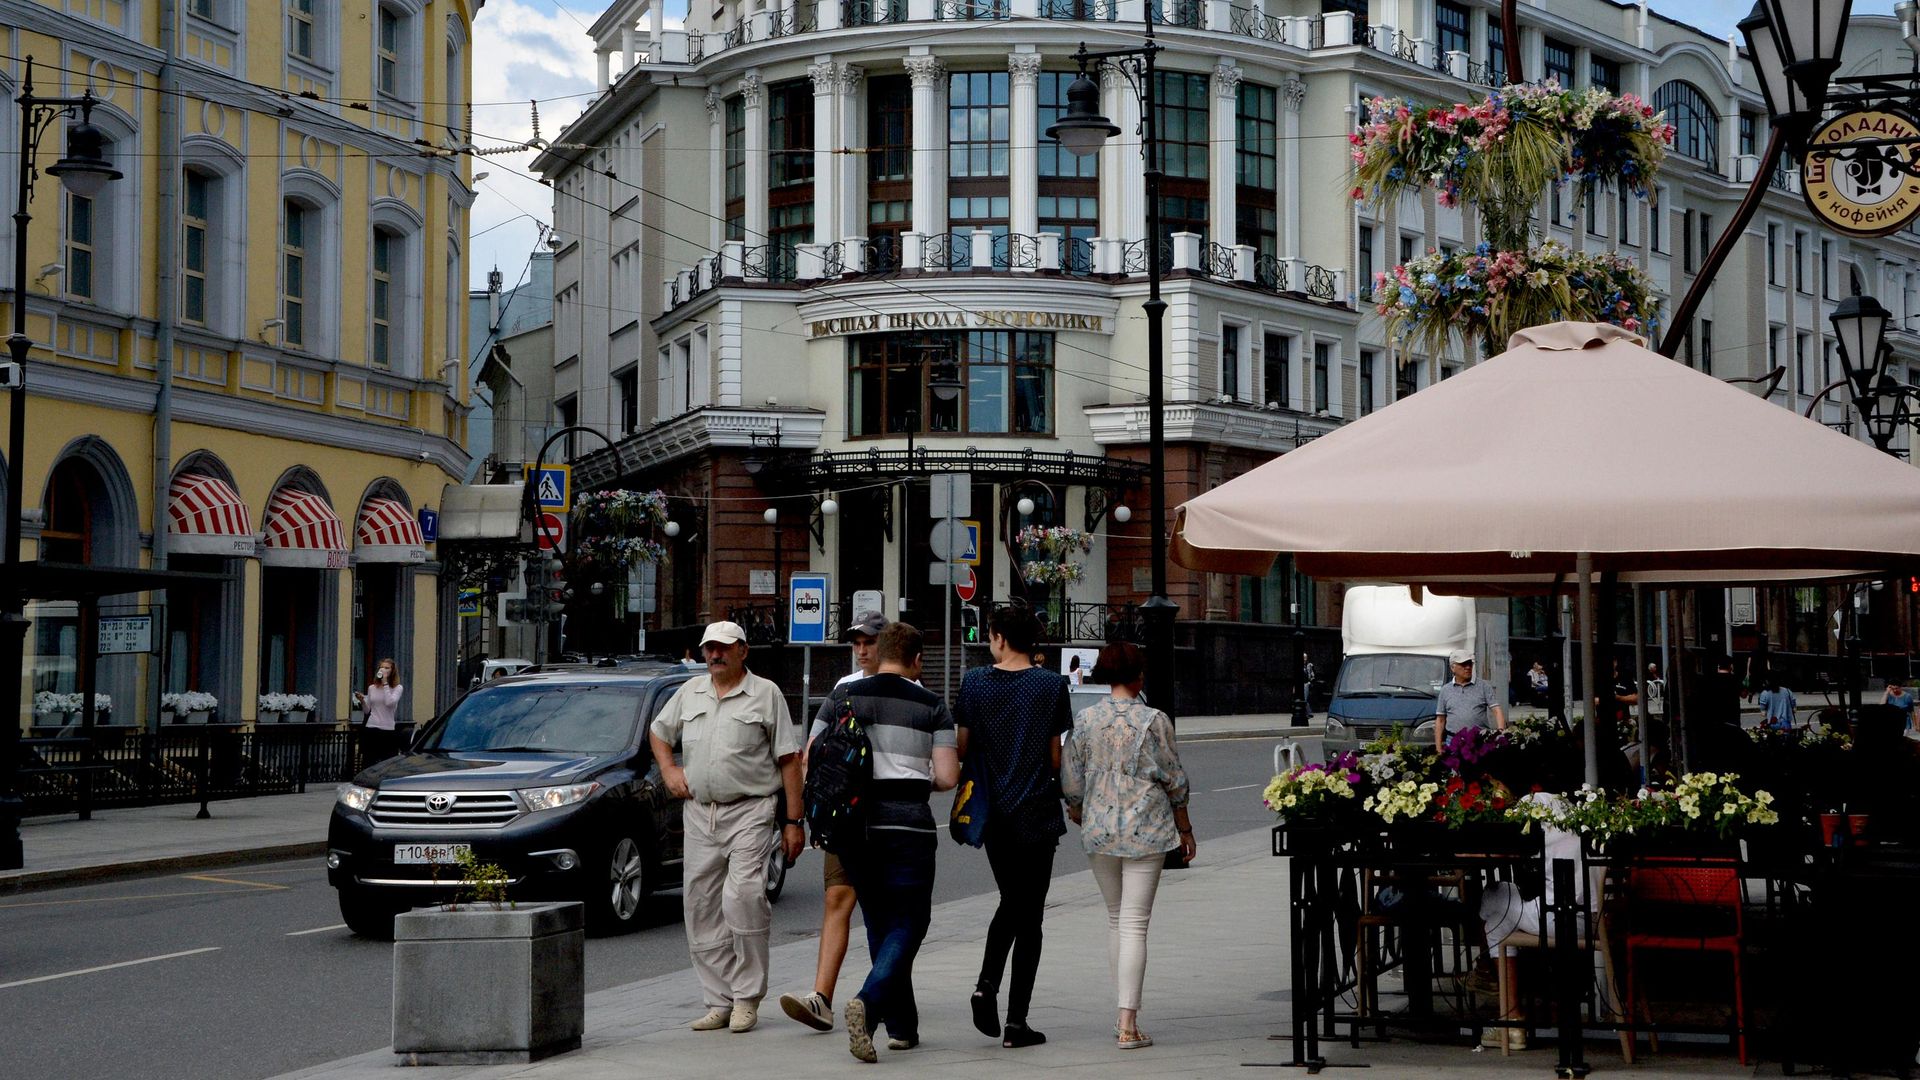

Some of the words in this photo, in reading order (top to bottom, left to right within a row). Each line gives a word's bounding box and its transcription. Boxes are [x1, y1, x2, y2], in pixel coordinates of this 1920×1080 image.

[1829, 196, 1909, 225] кофейня
[888, 311, 967, 329] ШКОЛА
[974, 311, 1103, 331] ЭКОНОМИКИ
[427, 515, 434, 532] 7
